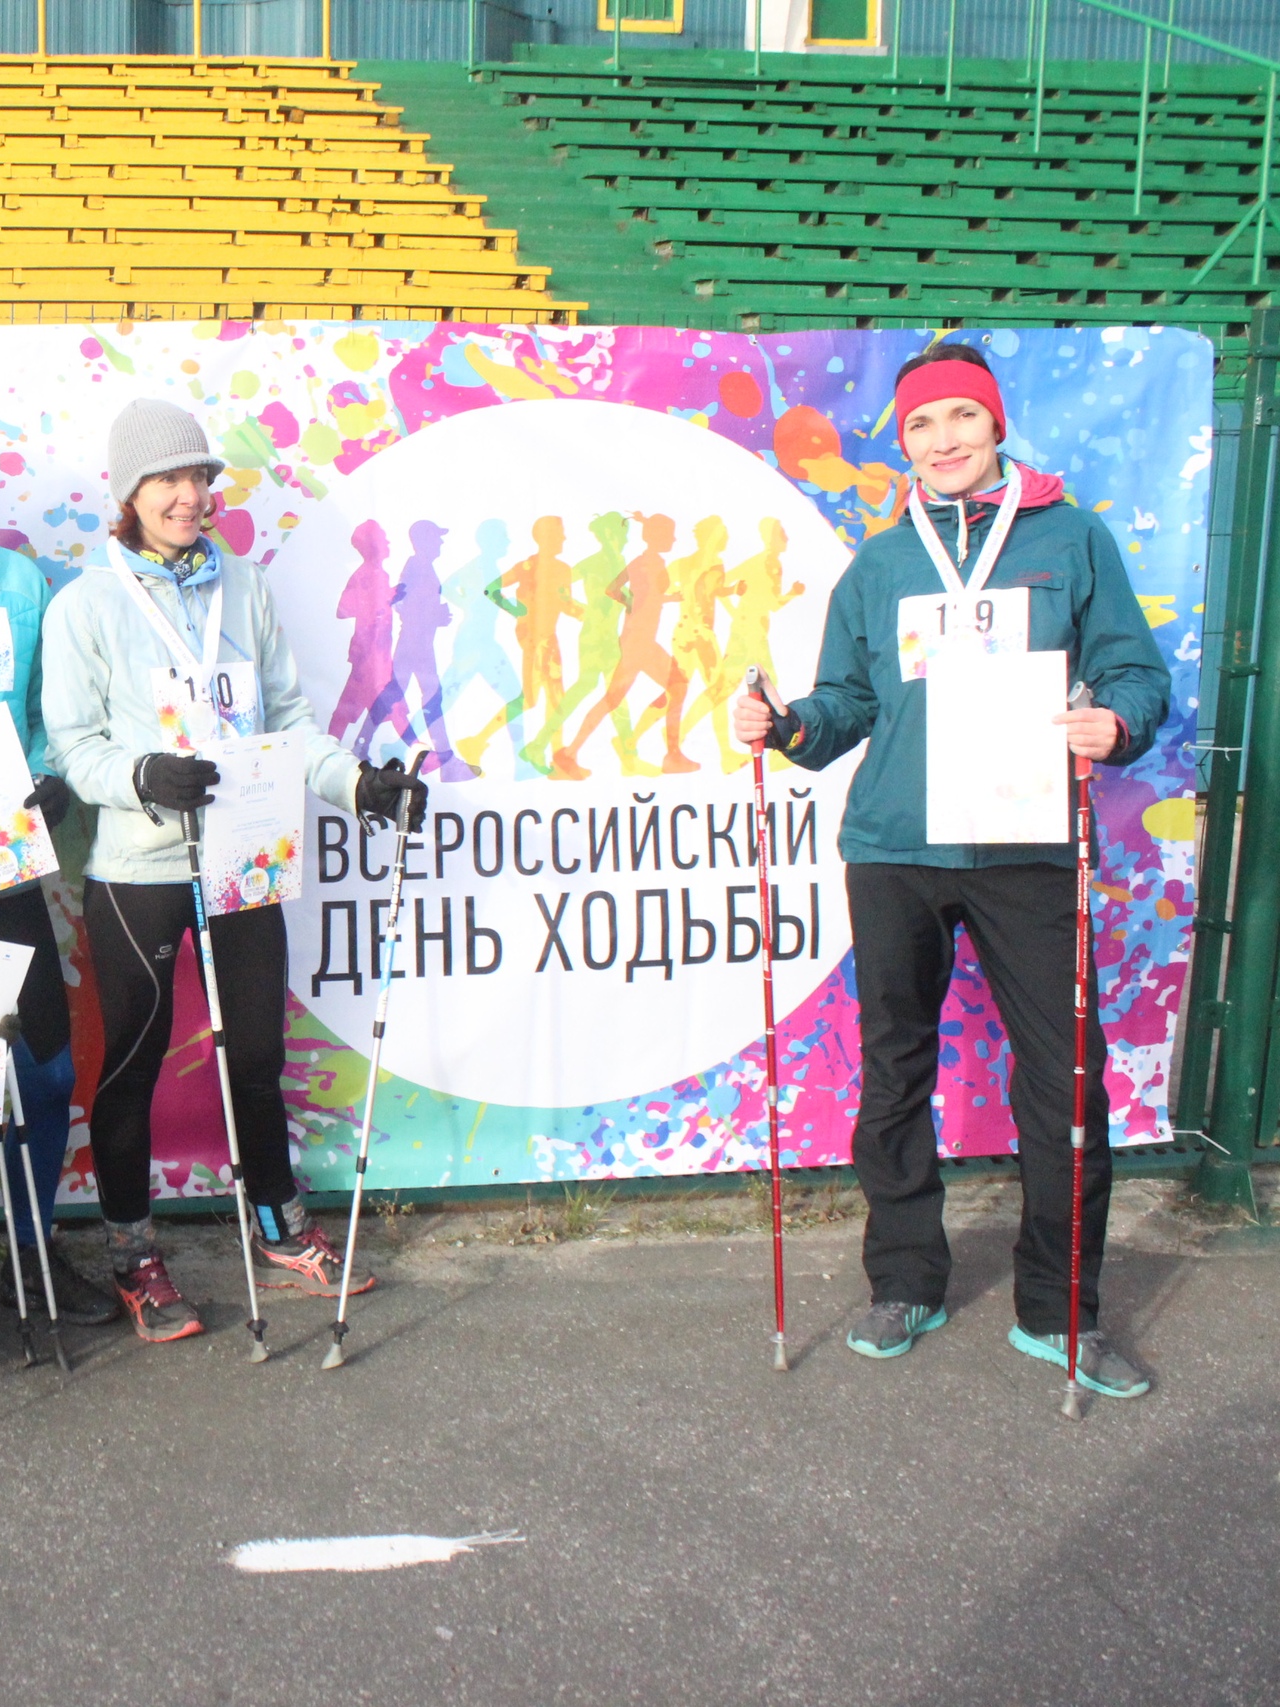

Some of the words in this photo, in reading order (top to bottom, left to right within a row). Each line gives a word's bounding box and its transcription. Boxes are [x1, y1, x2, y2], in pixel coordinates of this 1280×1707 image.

[239, 781, 275, 798] ДИПЛОМ
[318, 787, 818, 884] ВСЕРОССИЙСКИЙ
[311, 895, 503, 998] ДЕНЬ
[533, 882, 820, 983] ХОДЬБЫ
